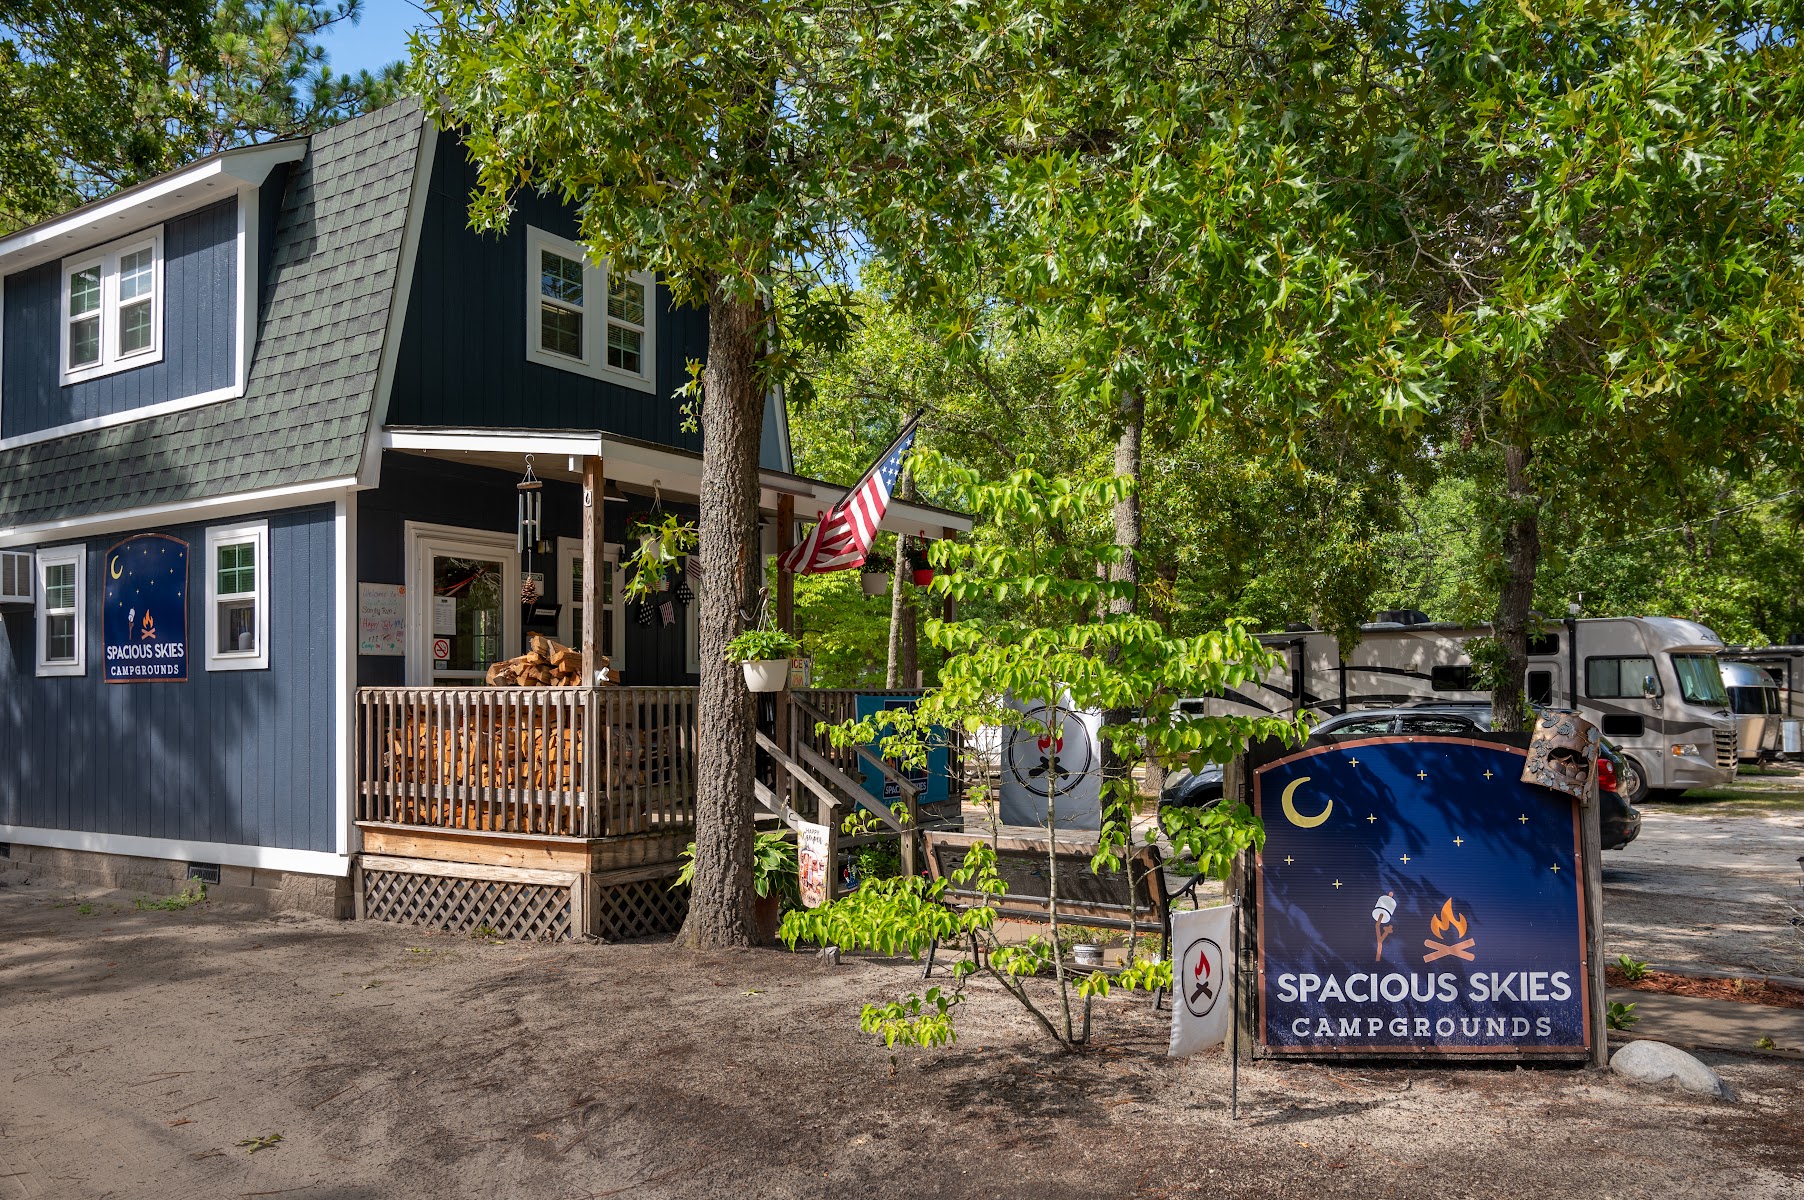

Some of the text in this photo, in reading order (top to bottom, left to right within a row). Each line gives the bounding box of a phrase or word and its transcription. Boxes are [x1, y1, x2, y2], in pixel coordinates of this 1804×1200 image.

[107, 642, 184, 660] SPACIOUS SKIES
[110, 665, 179, 676] CAMPGROUNDS
[791, 659, 803, 669] ICE
[1277, 971, 1572, 1003] SPACIOUS SKIES
[1291, 1016, 1552, 1037] CAMPGROUNDS
